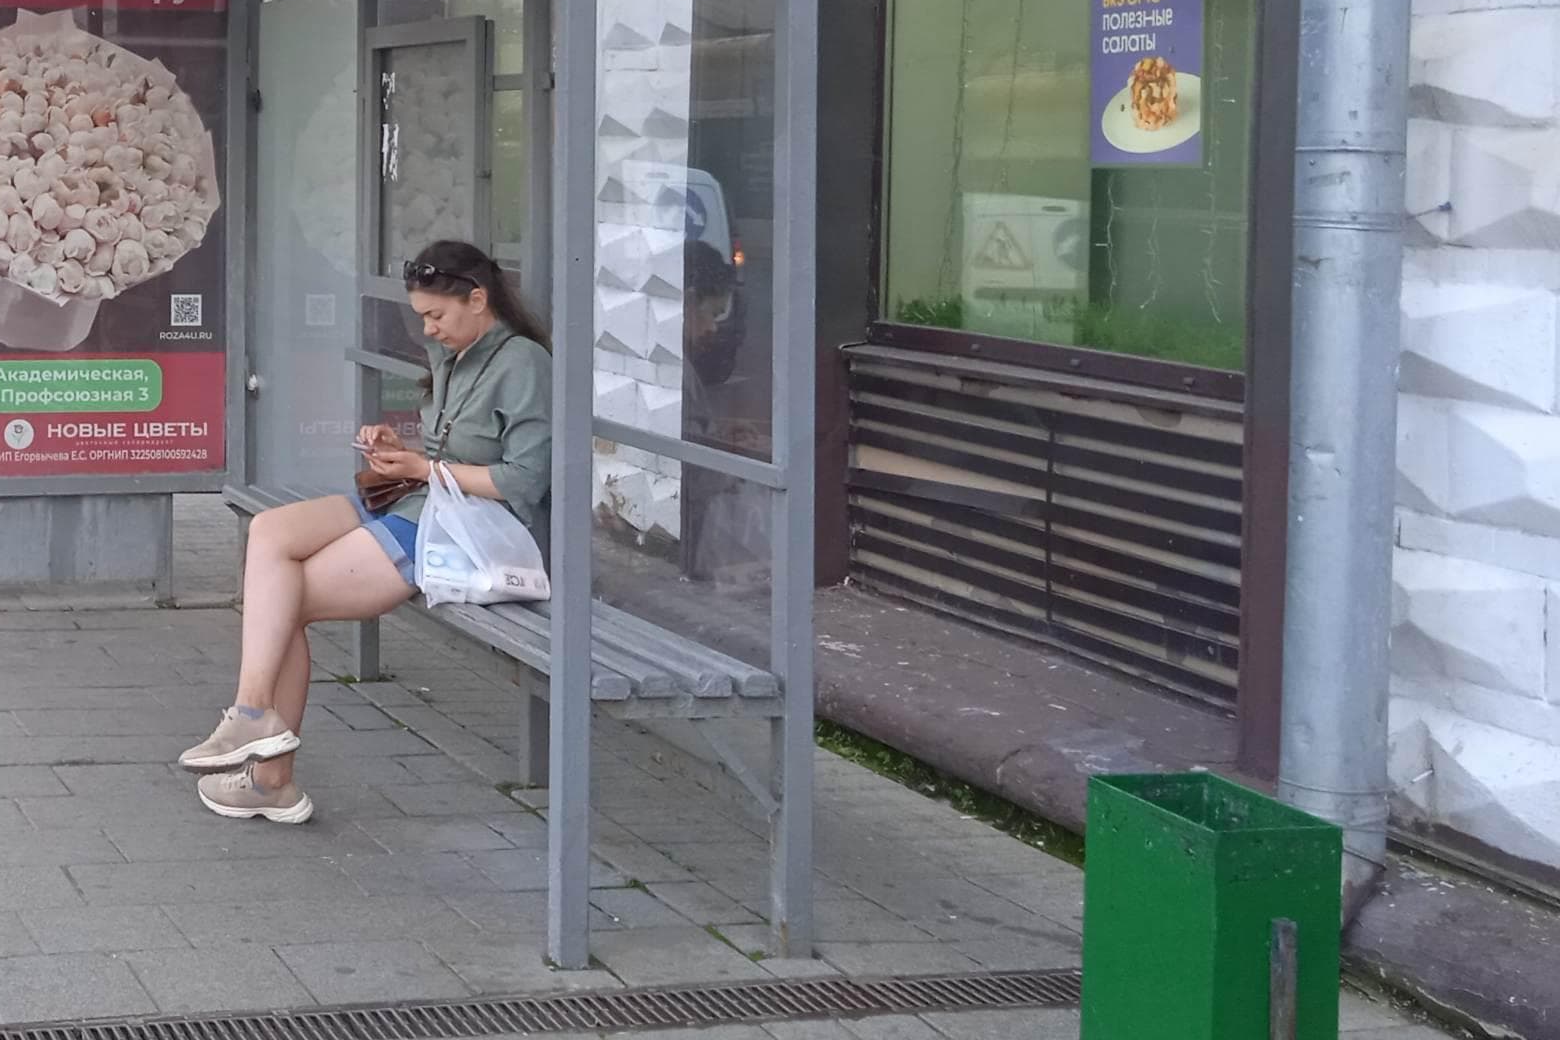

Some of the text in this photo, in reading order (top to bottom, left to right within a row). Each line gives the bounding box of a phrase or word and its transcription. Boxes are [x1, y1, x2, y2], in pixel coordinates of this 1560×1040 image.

[1102, 8, 1173, 31] полезные
[1102, 33, 1156, 54] салаты
[1, 387, 134, 405] Профсоюзная
[138, 387, 149, 402] 3
[47, 422, 208, 439] НОВЫЕ ЦВЕТЫ
